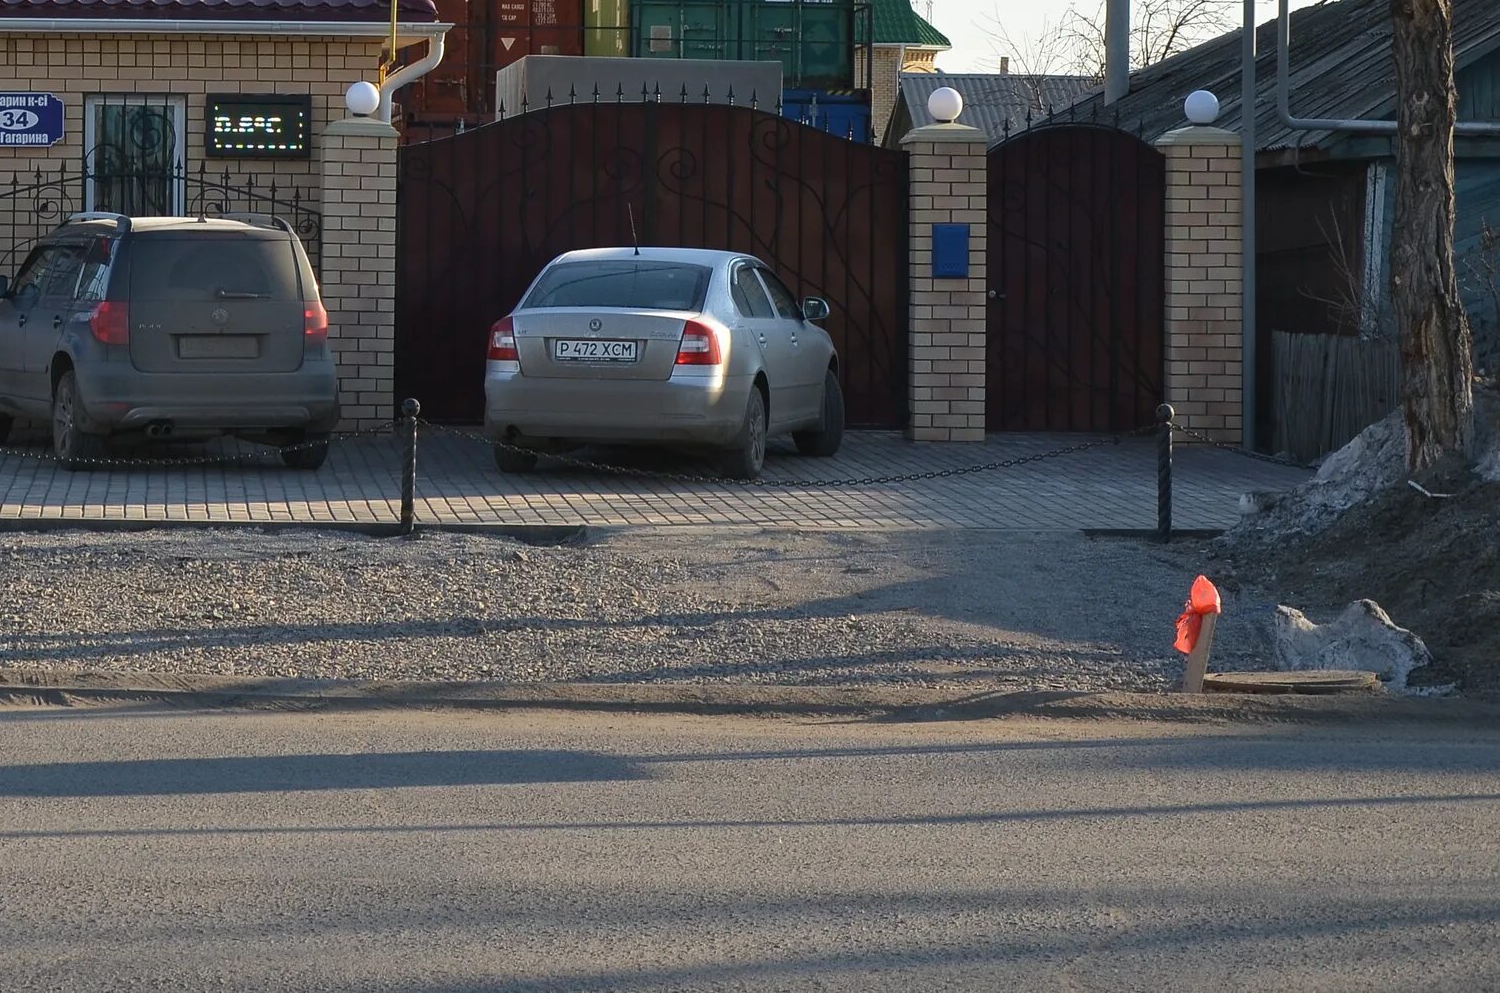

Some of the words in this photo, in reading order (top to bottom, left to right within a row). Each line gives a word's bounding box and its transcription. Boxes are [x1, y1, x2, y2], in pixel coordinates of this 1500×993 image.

[28, 95, 48, 107] к-сі
[2, 111, 29, 127] 34
[0, 132, 49, 144] Гагарина
[560, 342, 569, 355] P
[573, 342, 596, 356] 472
[601, 343, 632, 357] XCM
